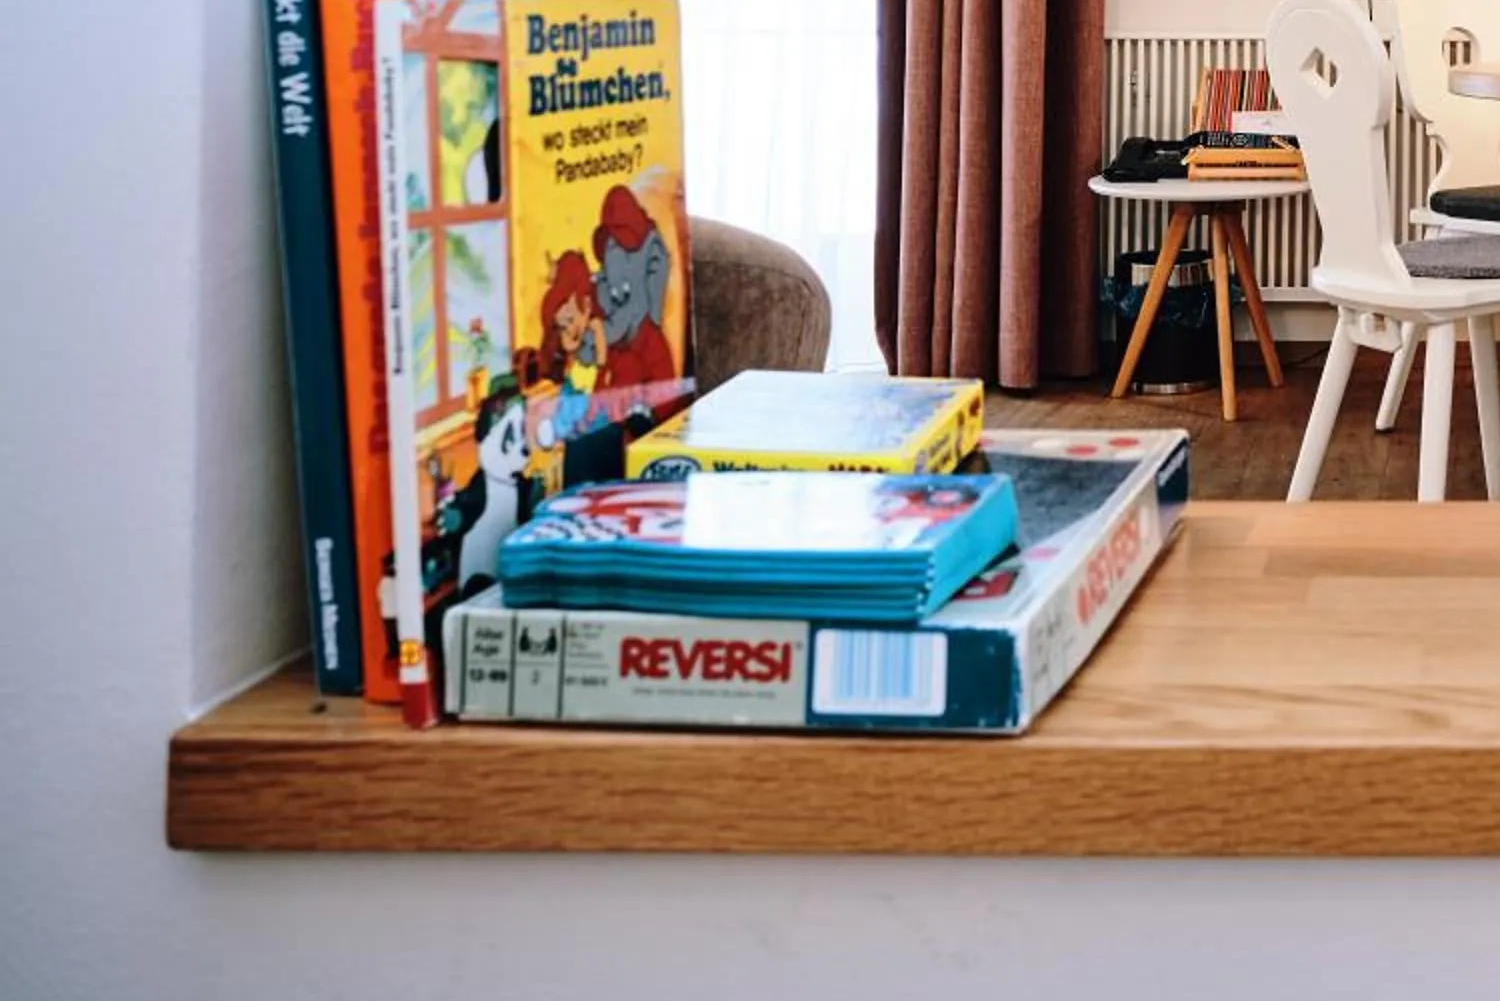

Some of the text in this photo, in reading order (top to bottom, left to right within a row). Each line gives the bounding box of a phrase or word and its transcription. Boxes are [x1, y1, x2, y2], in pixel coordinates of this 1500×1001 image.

[277, 31, 306, 67] die
[527, 9, 655, 61] Benjamin
[279, 72, 313, 137] Welt
[528, 58, 671, 116] Blümchen,
[543, 116, 649, 151] wo steckt mein
[555, 143, 643, 186] Pandababy?
[620, 636, 791, 683] REVERSI
